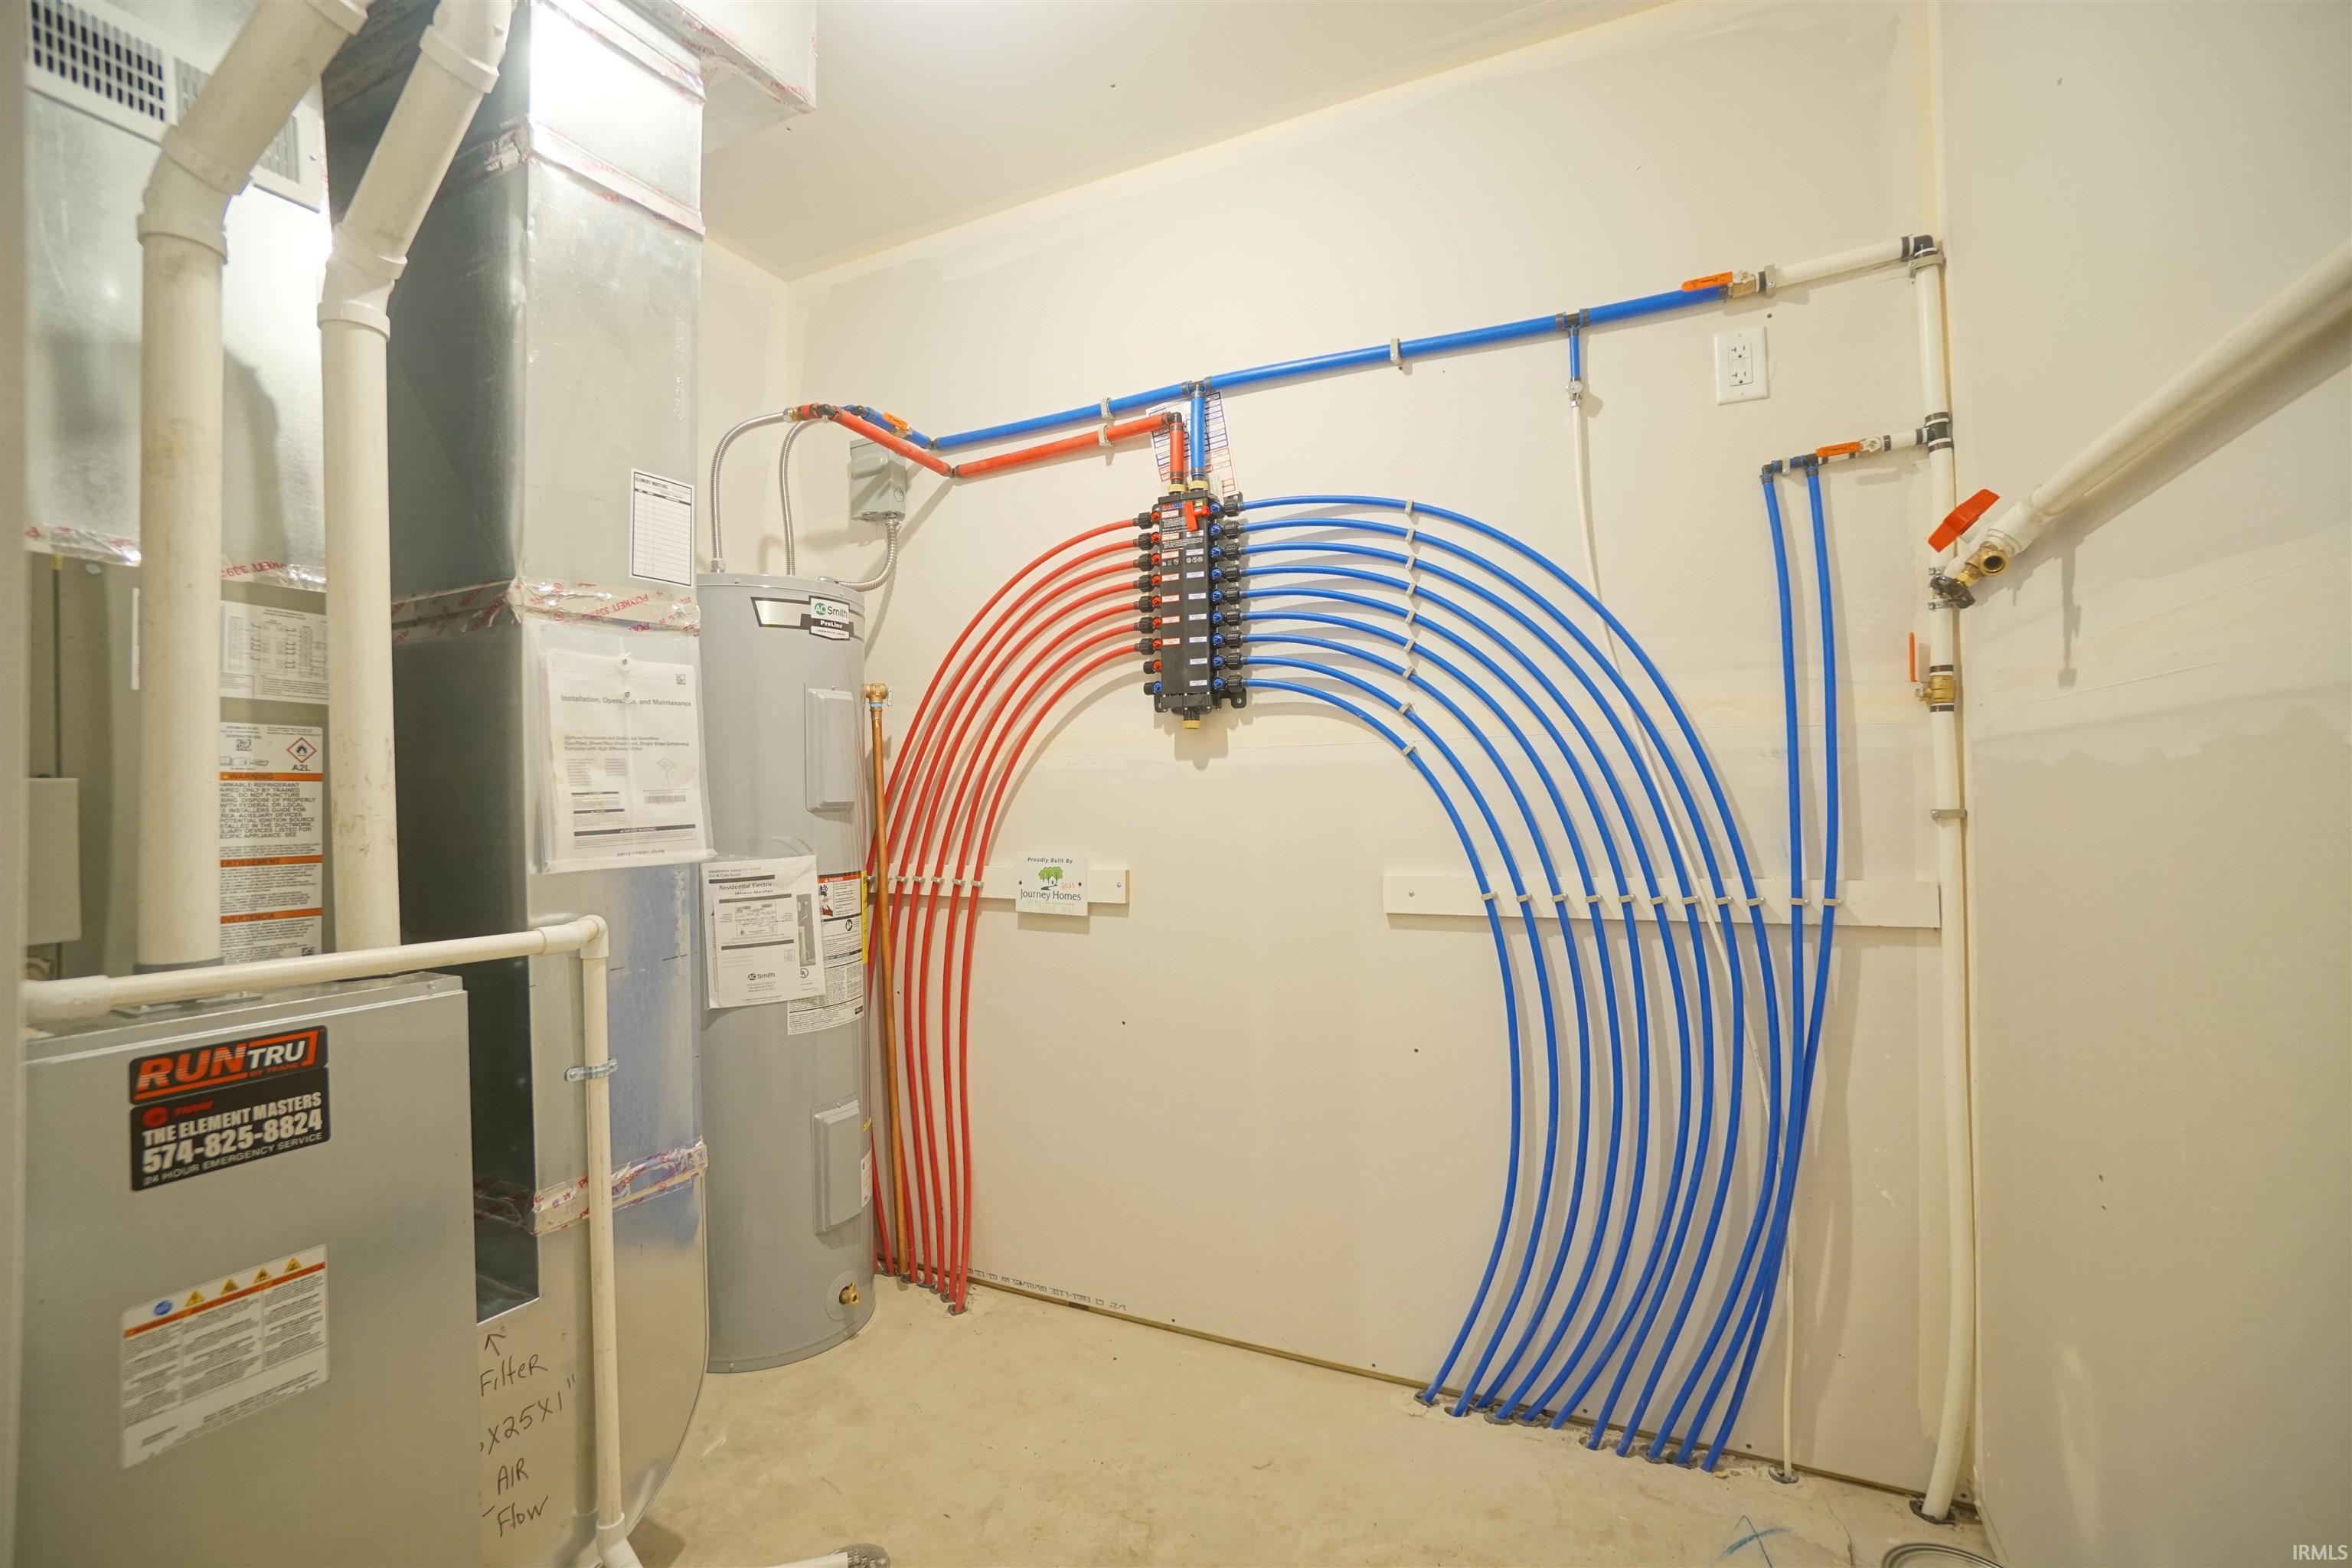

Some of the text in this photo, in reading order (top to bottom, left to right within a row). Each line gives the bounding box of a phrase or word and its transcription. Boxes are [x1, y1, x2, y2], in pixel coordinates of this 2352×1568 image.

[828, 606, 848, 618] Smith
[560, 694, 601, 704] Installation,
[1020, 888, 1081, 900] Journey Homes
[142, 1092, 322, 1147] THE ELEMENT MASTERS
[142, 1109, 323, 1174] 574-825-8824
[144, 1132, 323, 1186] 24 HOUR EMERGENCY SERVICE
[498, 1458, 529, 1495] AIR
